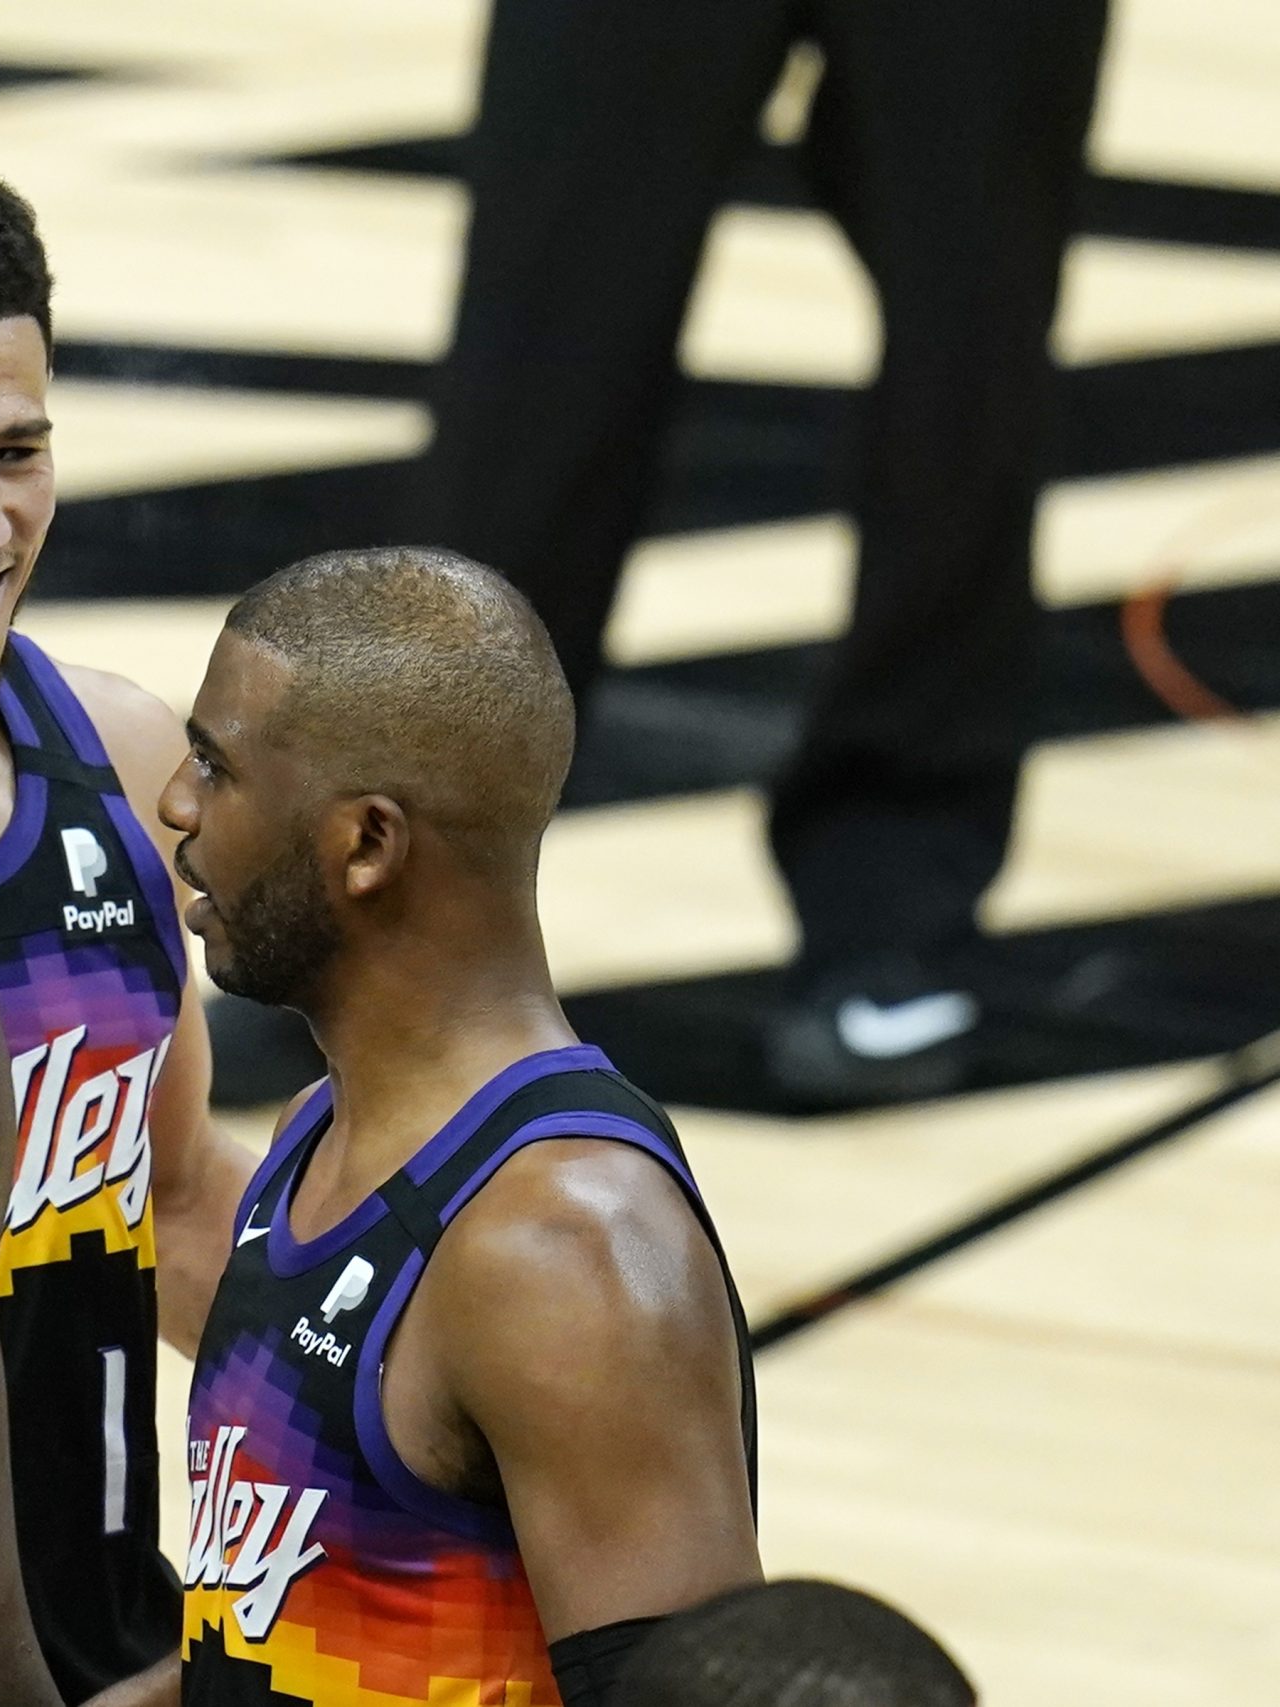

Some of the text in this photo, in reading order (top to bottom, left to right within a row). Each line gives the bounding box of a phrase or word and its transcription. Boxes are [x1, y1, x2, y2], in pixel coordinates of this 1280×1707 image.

[62, 900, 135, 933] PayPal
[290, 1316, 352, 1367] PayPal
[190, 1440, 210, 1472] THE
